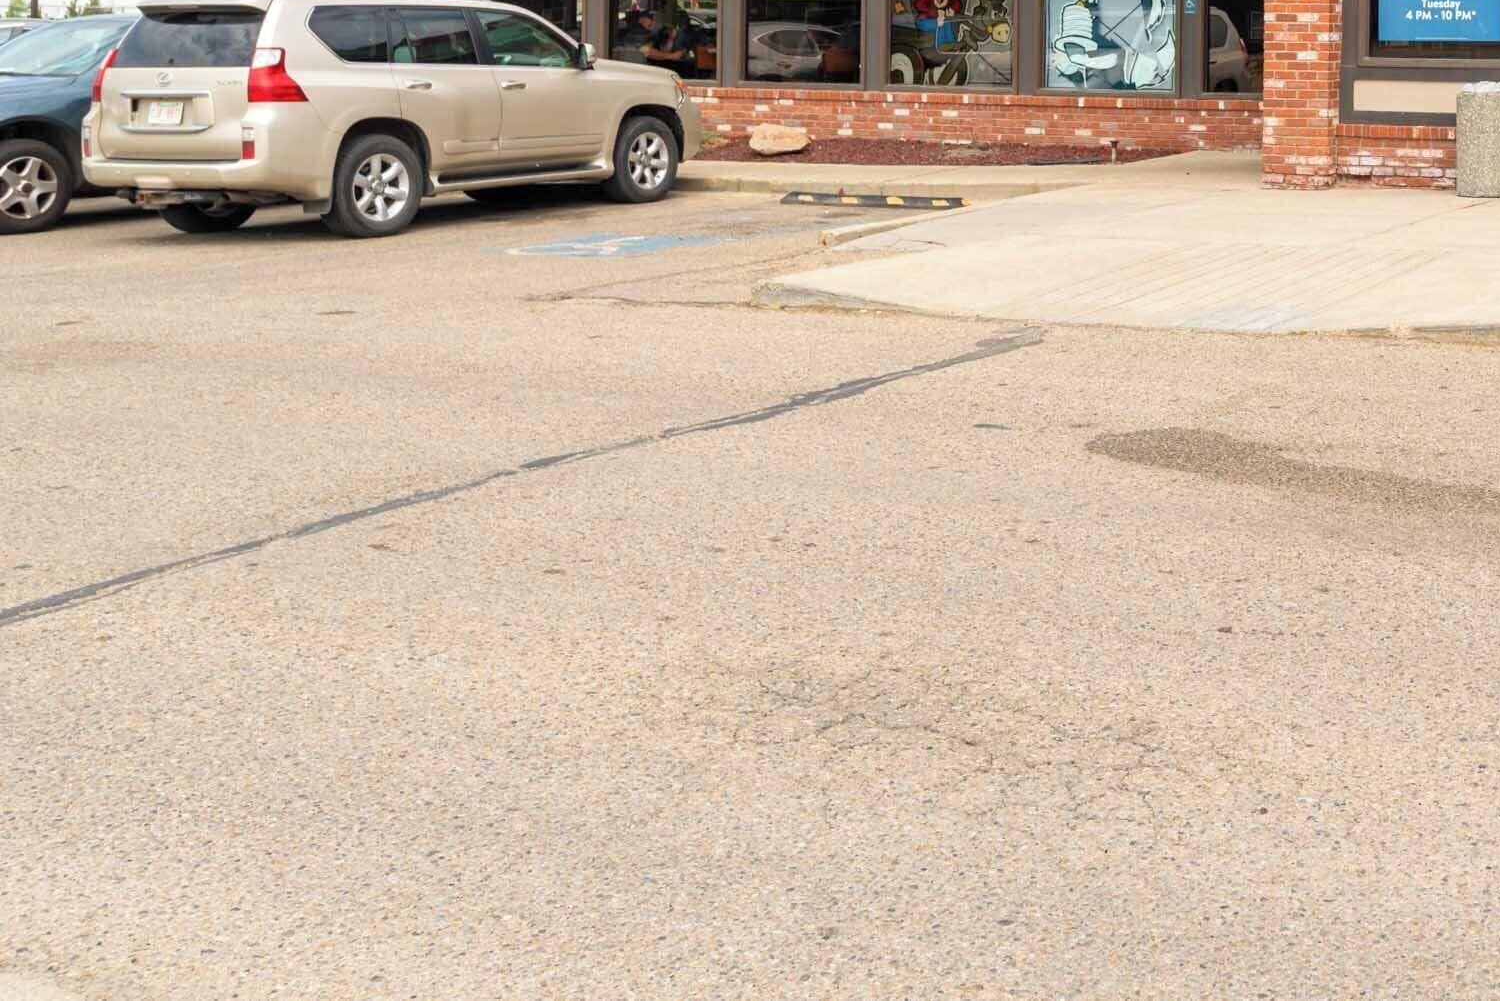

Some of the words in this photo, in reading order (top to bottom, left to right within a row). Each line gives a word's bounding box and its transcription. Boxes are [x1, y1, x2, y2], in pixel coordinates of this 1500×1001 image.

[1405, 10, 1414, 20] 4
[1415, 10, 1432, 20] PM
[1441, 10, 1453, 20] 10
